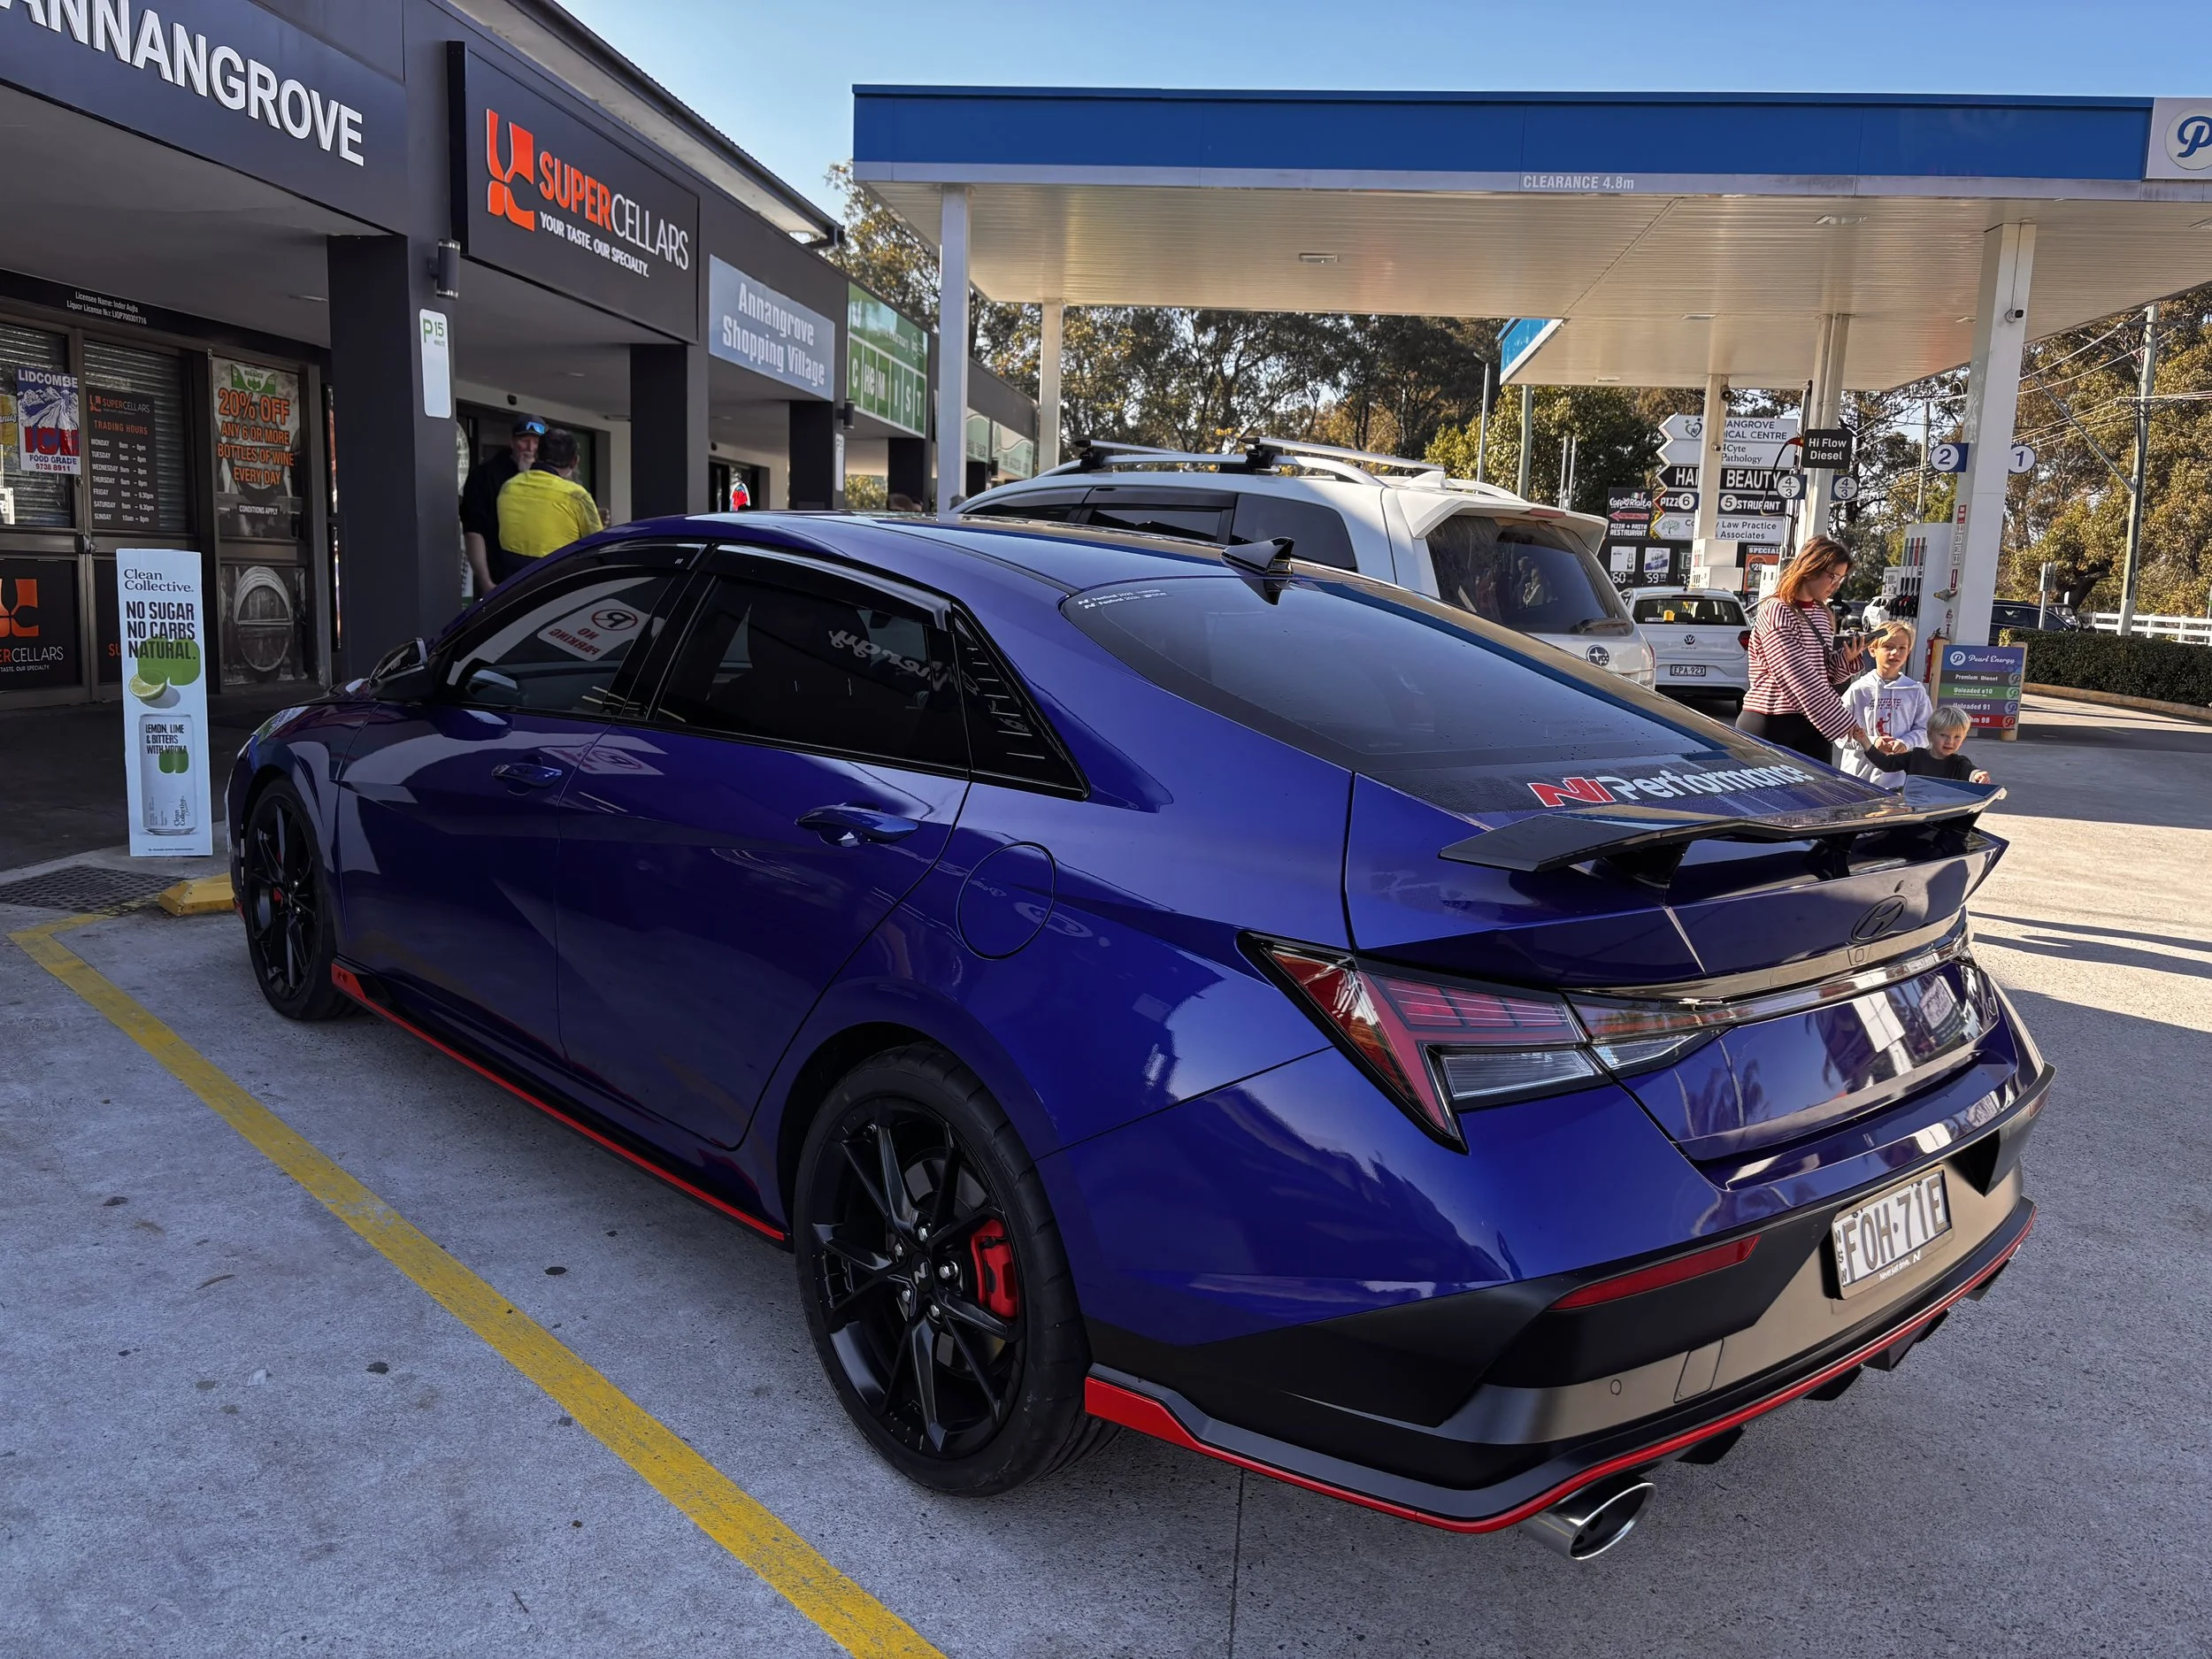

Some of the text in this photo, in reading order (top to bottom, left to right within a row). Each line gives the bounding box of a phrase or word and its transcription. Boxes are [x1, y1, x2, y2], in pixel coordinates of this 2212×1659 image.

[1524, 175, 1634, 189] CLEARANCE 4.8m
[539, 151, 688, 270] SUPERCELLARS
[540, 211, 565, 237] YOUR
[593, 238, 610, 258] OUR
[75, 291, 96, 303] Licensee
[97, 297, 113, 307] Name:
[66, 300, 82, 311] Liquor
[83, 304, 102, 316] License
[738, 282, 813, 346] Annangrove
[423, 319, 444, 343] P 15
[723, 315, 825, 387] Shopping Village
[18, 369, 79, 389] LIDCOMBE
[102, 398, 150, 413] SUPERCELLARS
[219, 388, 290, 426] 20% OFF
[94, 419, 148, 435] TRADING HOURS
[1725, 420, 1775, 429] ANGROVE
[221, 420, 290, 445] ANY 6 OR MORE
[25, 426, 80, 457] ICE
[1809, 438, 1847, 448] Hi Flow
[29, 454, 77, 465] FOOD GRADE
[91, 450, 111, 459] TUESDAY
[218, 443, 295, 466] BOTTLES OF WINE
[1810, 450, 1842, 460] Diesel
[1938, 449, 1951, 465] 2
[2016, 450, 2024, 467] 1
[92, 475, 115, 484] THURSDAY
[234, 466, 281, 486] EVERY DAY
[1675, 467, 1780, 488] HAI BEAUTY
[1785, 477, 1793, 486] 4
[1841, 478, 1849, 487] 4
[1786, 488, 1793, 497] 3
[1841, 489, 1848, 498] 3
[1683, 496, 1690, 505] 6
[1724, 497, 1733, 506] 5
[1737, 500, 1780, 511] STAURANT
[239, 504, 265, 514] CONDITIONS
[1722, 520, 1740, 529] Law
[1742, 520, 1777, 530] Practice
[1721, 531, 1765, 540] Associates
[124, 568, 163, 580] Clean
[124, 580, 195, 593] Collective.
[126, 601, 195, 620] NO SUGAR
[127, 620, 196, 640] NO CARBS
[128, 641, 196, 660] NATURAL.
[1990, 656, 2016, 664] Energy
[170, 724, 185, 733] LIME
[146, 734, 179, 744] & BITTERS
[146, 745, 188, 755] WITH VODKA
[1595, 764, 1815, 800] Performance
